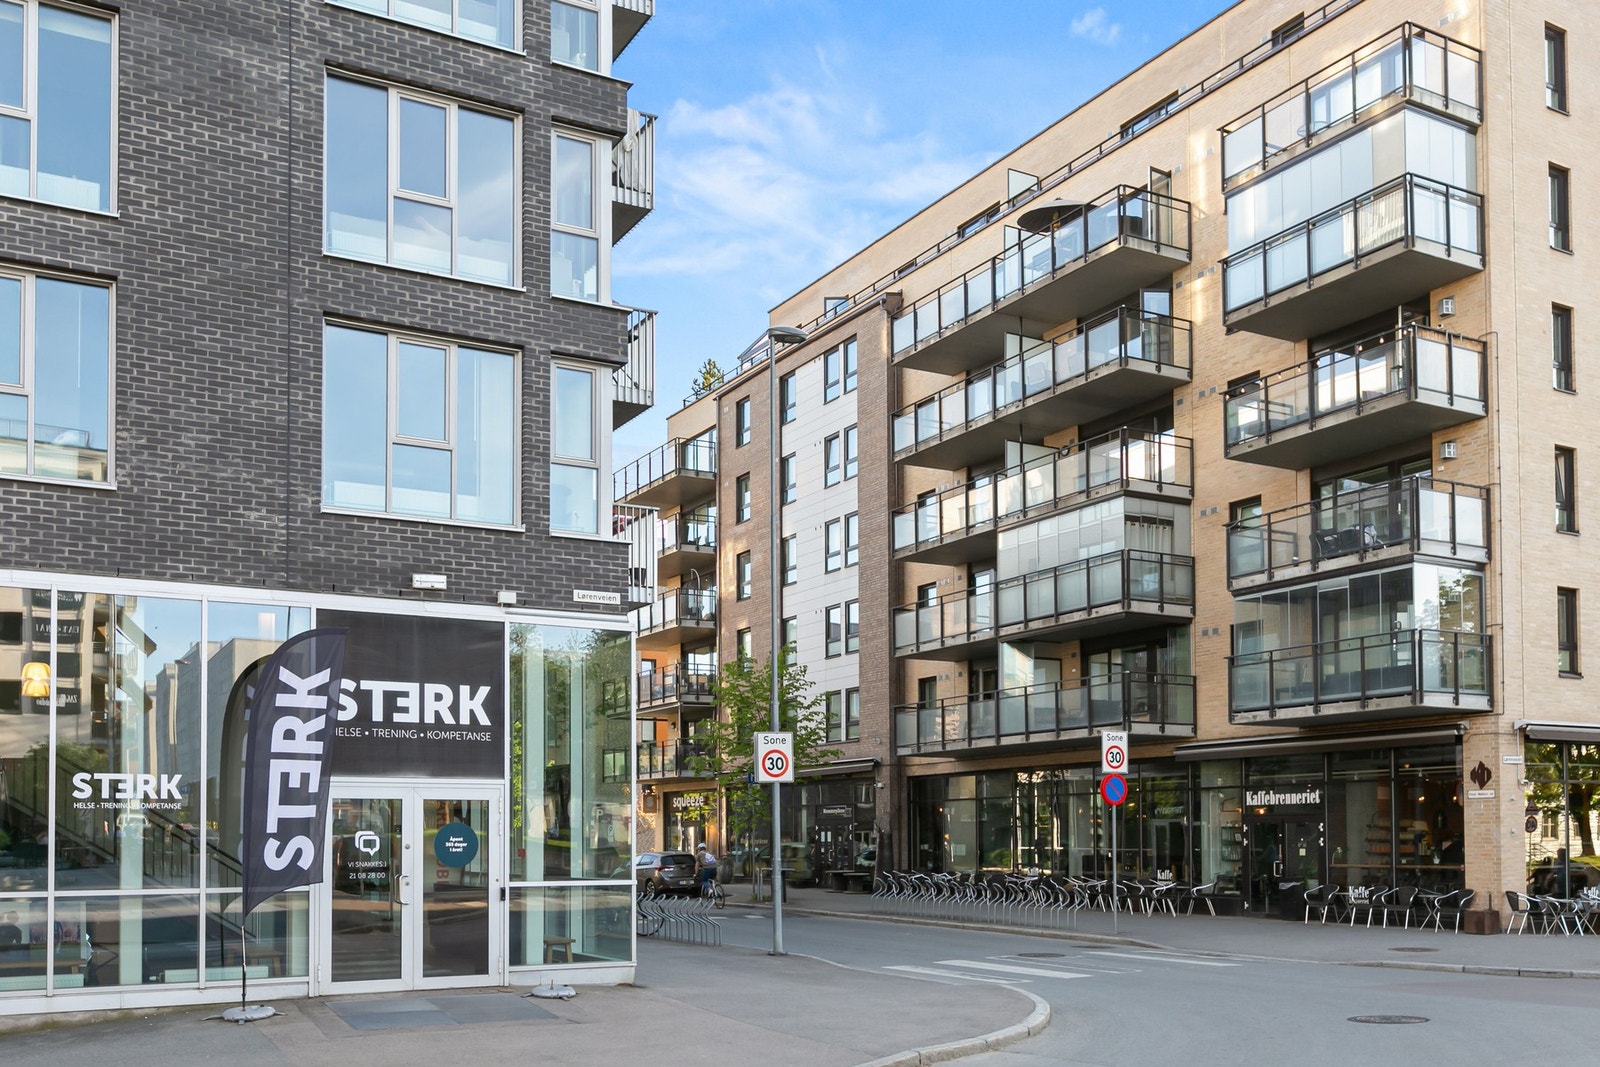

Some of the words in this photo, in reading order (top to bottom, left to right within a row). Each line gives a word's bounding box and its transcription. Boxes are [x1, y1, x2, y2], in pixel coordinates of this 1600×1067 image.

[577, 591, 617, 602] Lørenveien
[372, 728, 418, 739] TRENING
[427, 730, 492, 742] KOMPETANSE
[763, 735, 787, 745] Sone
[1106, 733, 1124, 742] Sone
[767, 756, 784, 771] 30
[1109, 751, 1122, 764] 30
[672, 795, 704, 811] squeeze
[1246, 788, 1321, 806] Kaffebrenneriet
